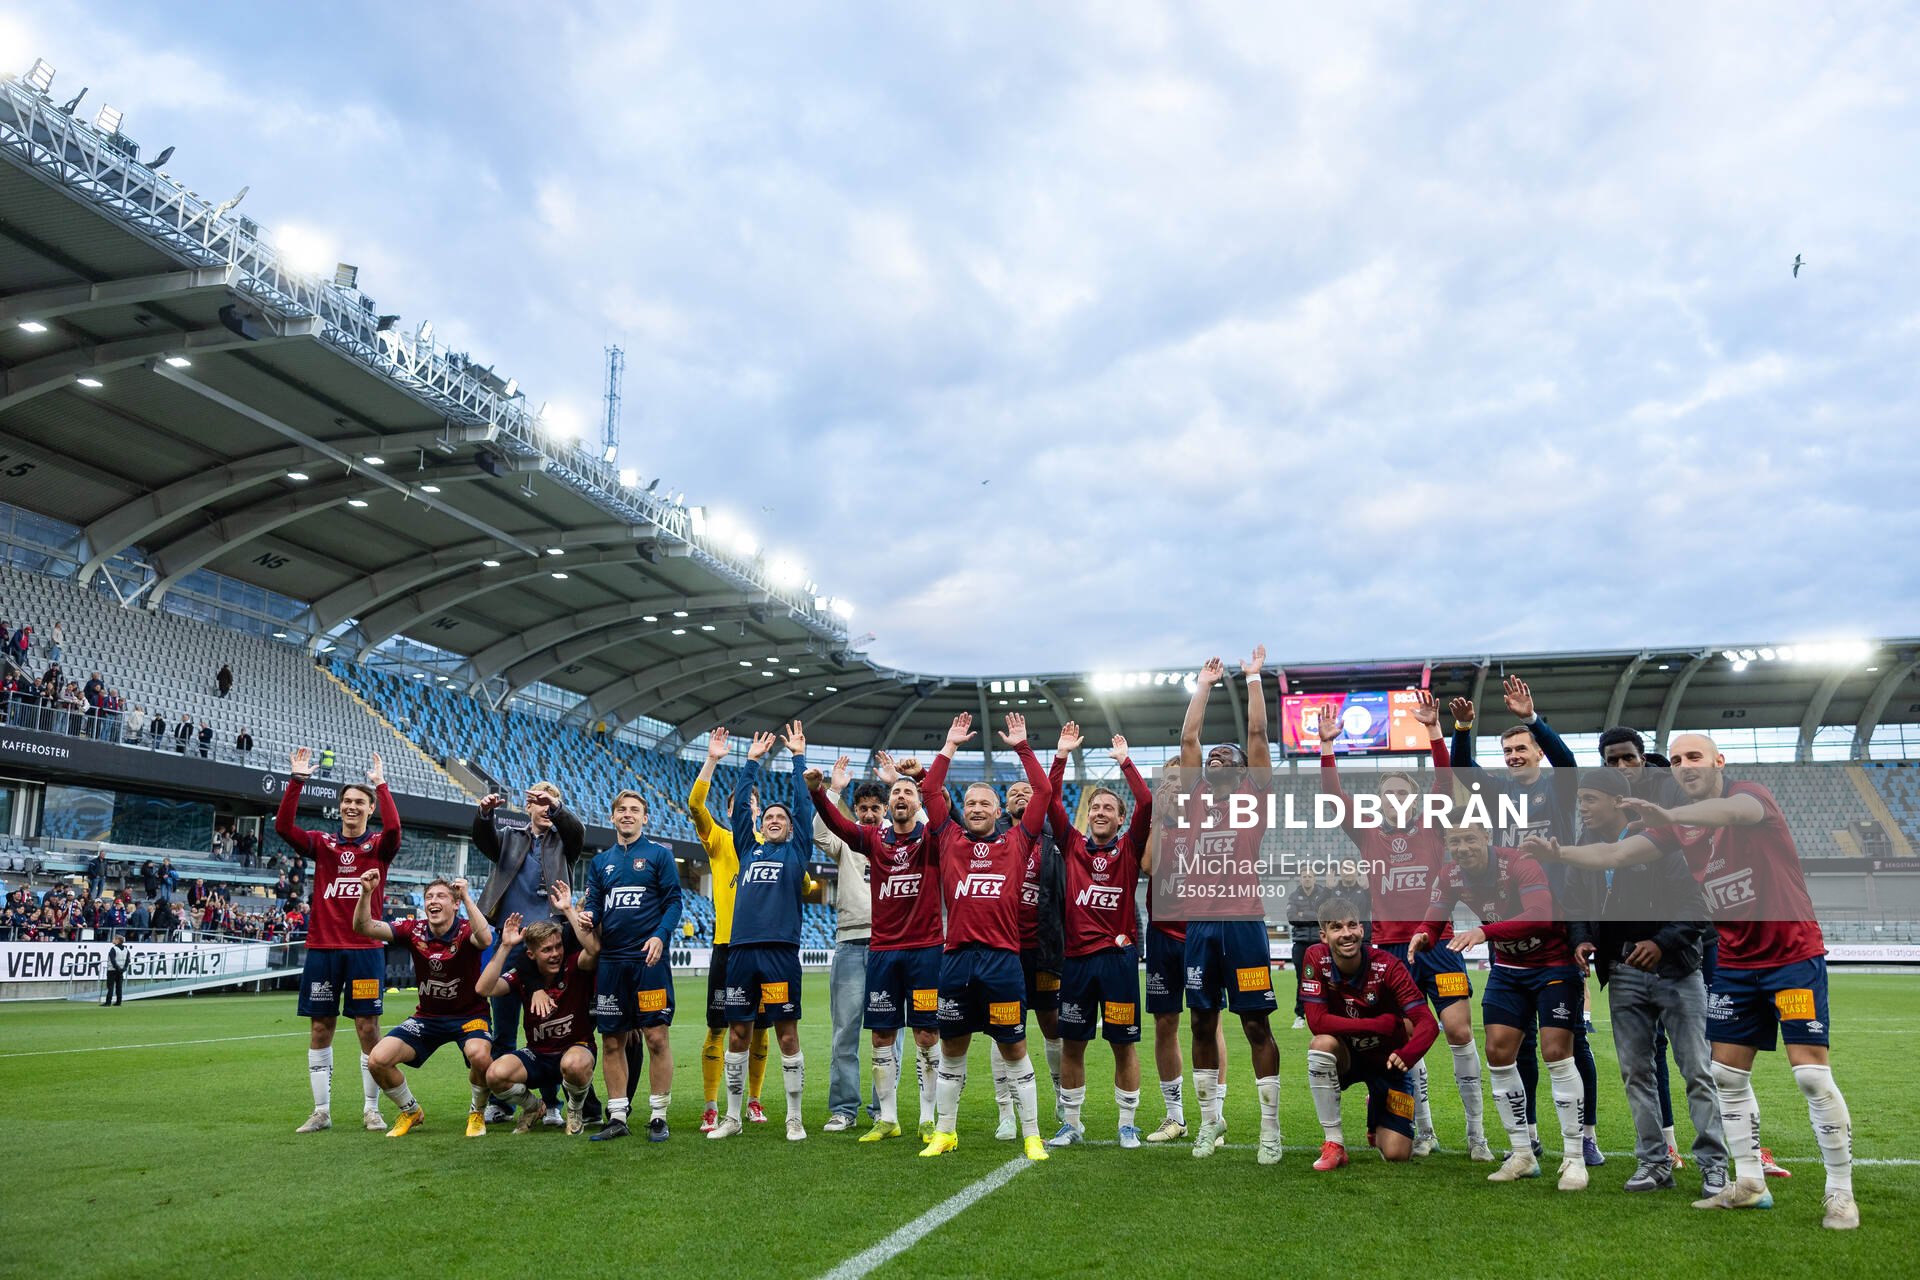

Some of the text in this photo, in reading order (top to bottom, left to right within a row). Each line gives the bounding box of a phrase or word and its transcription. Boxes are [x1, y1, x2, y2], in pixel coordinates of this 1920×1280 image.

[253, 552, 289, 570] N5
[432, 616, 459, 630] N4
[1722, 709, 1746, 719] B3
[2, 739, 70, 759] KAFFEROSTERI
[311, 785, 337, 799] KOPPEN
[1193, 830, 1238, 860] NTEX
[742, 861, 784, 887] NTEX
[1382, 866, 1429, 895] NTEX
[879, 873, 922, 900] NTEX
[954, 873, 1006, 900] NTEX
[1701, 867, 1757, 915] NTEX
[604, 886, 647, 912] NTEX
[1075, 884, 1124, 911] NTEX
[8, 945, 221, 977] VEM GÖR STA MÅL?
[1240, 970, 1265, 980] TRIUMF
[1242, 978, 1265, 987] GLASS
[1439, 976, 1465, 986] TRIUMF
[419, 978, 461, 1000] NTEX
[1442, 983, 1465, 992] GLASS
[643, 1000, 663, 1008] GLASS
[1778, 993, 1808, 1005] TRIUMF
[993, 1005, 1017, 1014] TRIUMF
[995, 1012, 1016, 1021] GLASS
[533, 1013, 575, 1042] NTEX
[1351, 1036, 1380, 1051] TEX
[1505, 1089, 1527, 1127] MIKE
